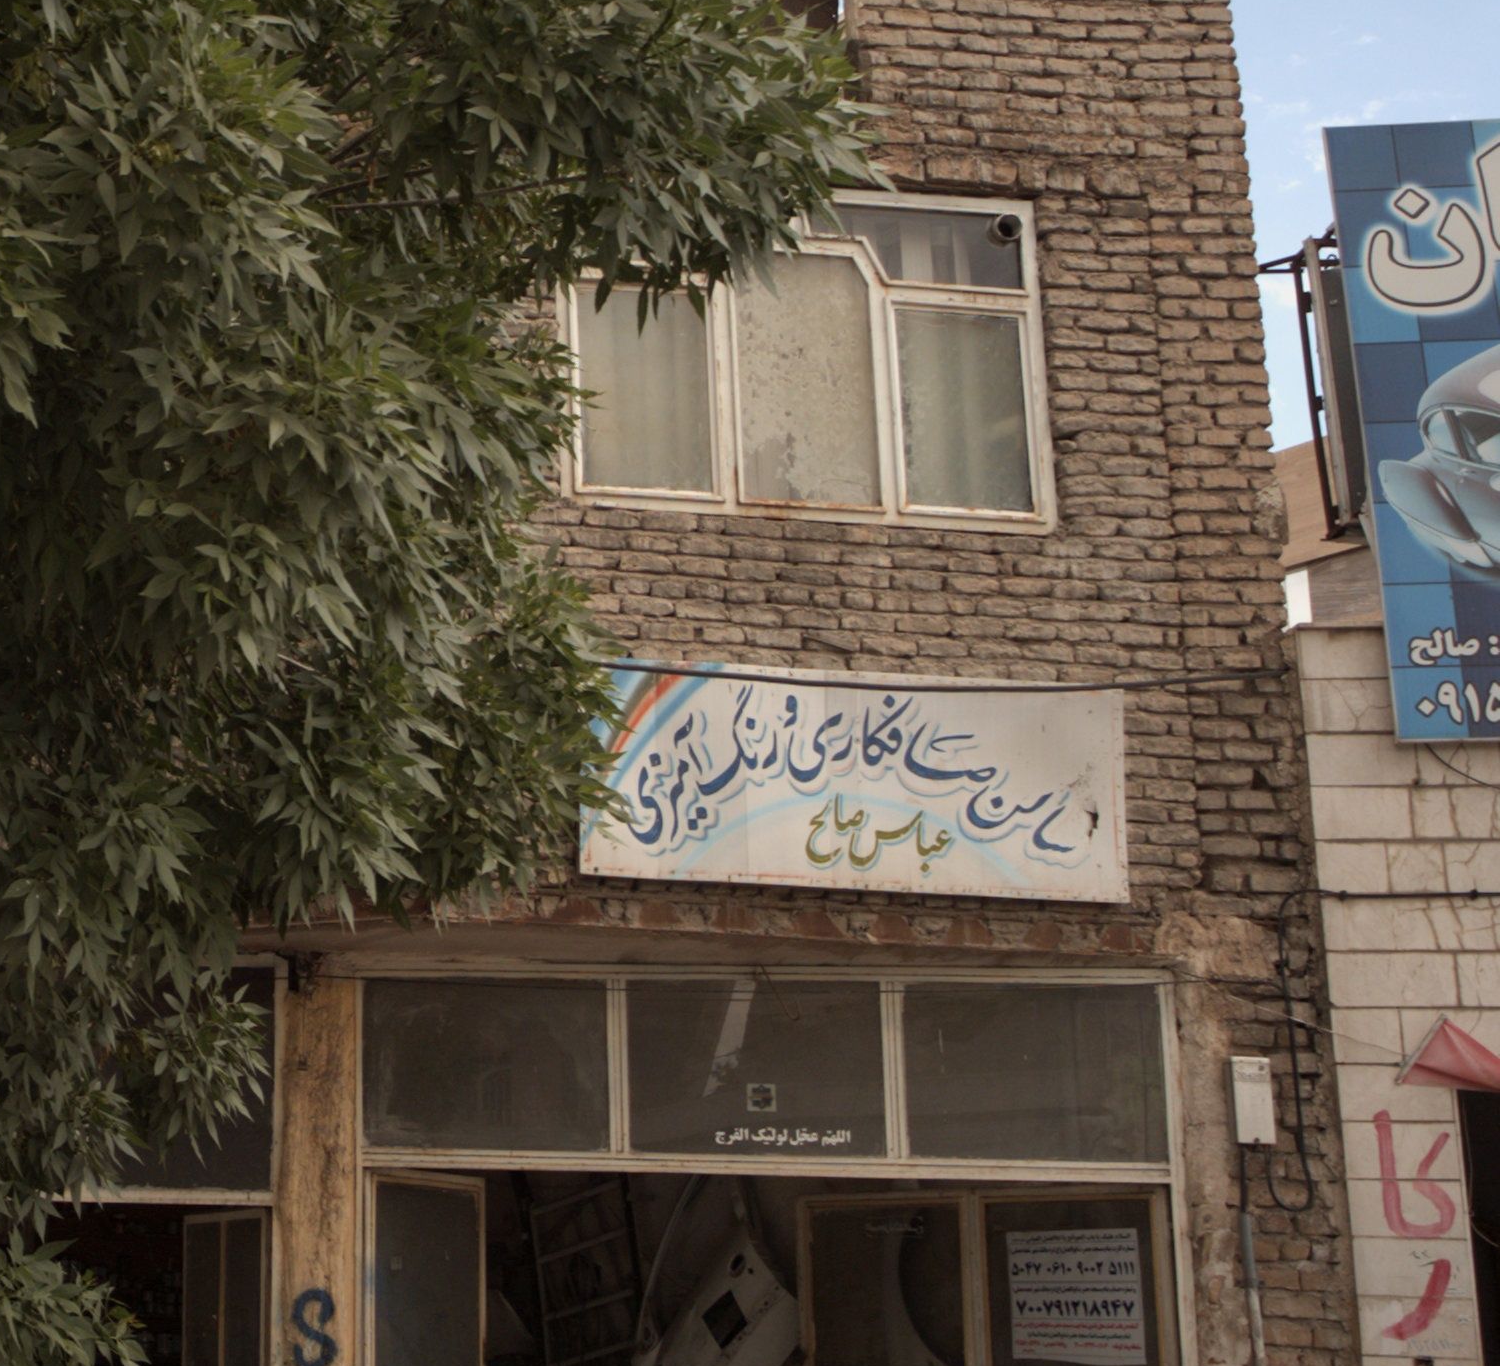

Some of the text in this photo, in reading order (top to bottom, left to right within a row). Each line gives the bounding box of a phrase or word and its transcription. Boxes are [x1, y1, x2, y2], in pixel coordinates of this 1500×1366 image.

[1408, 627, 1481, 667] صالح
[699, 683, 779, 797] رنگ
[783, 694, 799, 728] و
[787, 694, 997, 785] صافکاری
[629, 712, 708, 846] آمیزی
[804, 792, 955, 872] عباس صالح
[715, 1127, 749, 1145] الفرج
